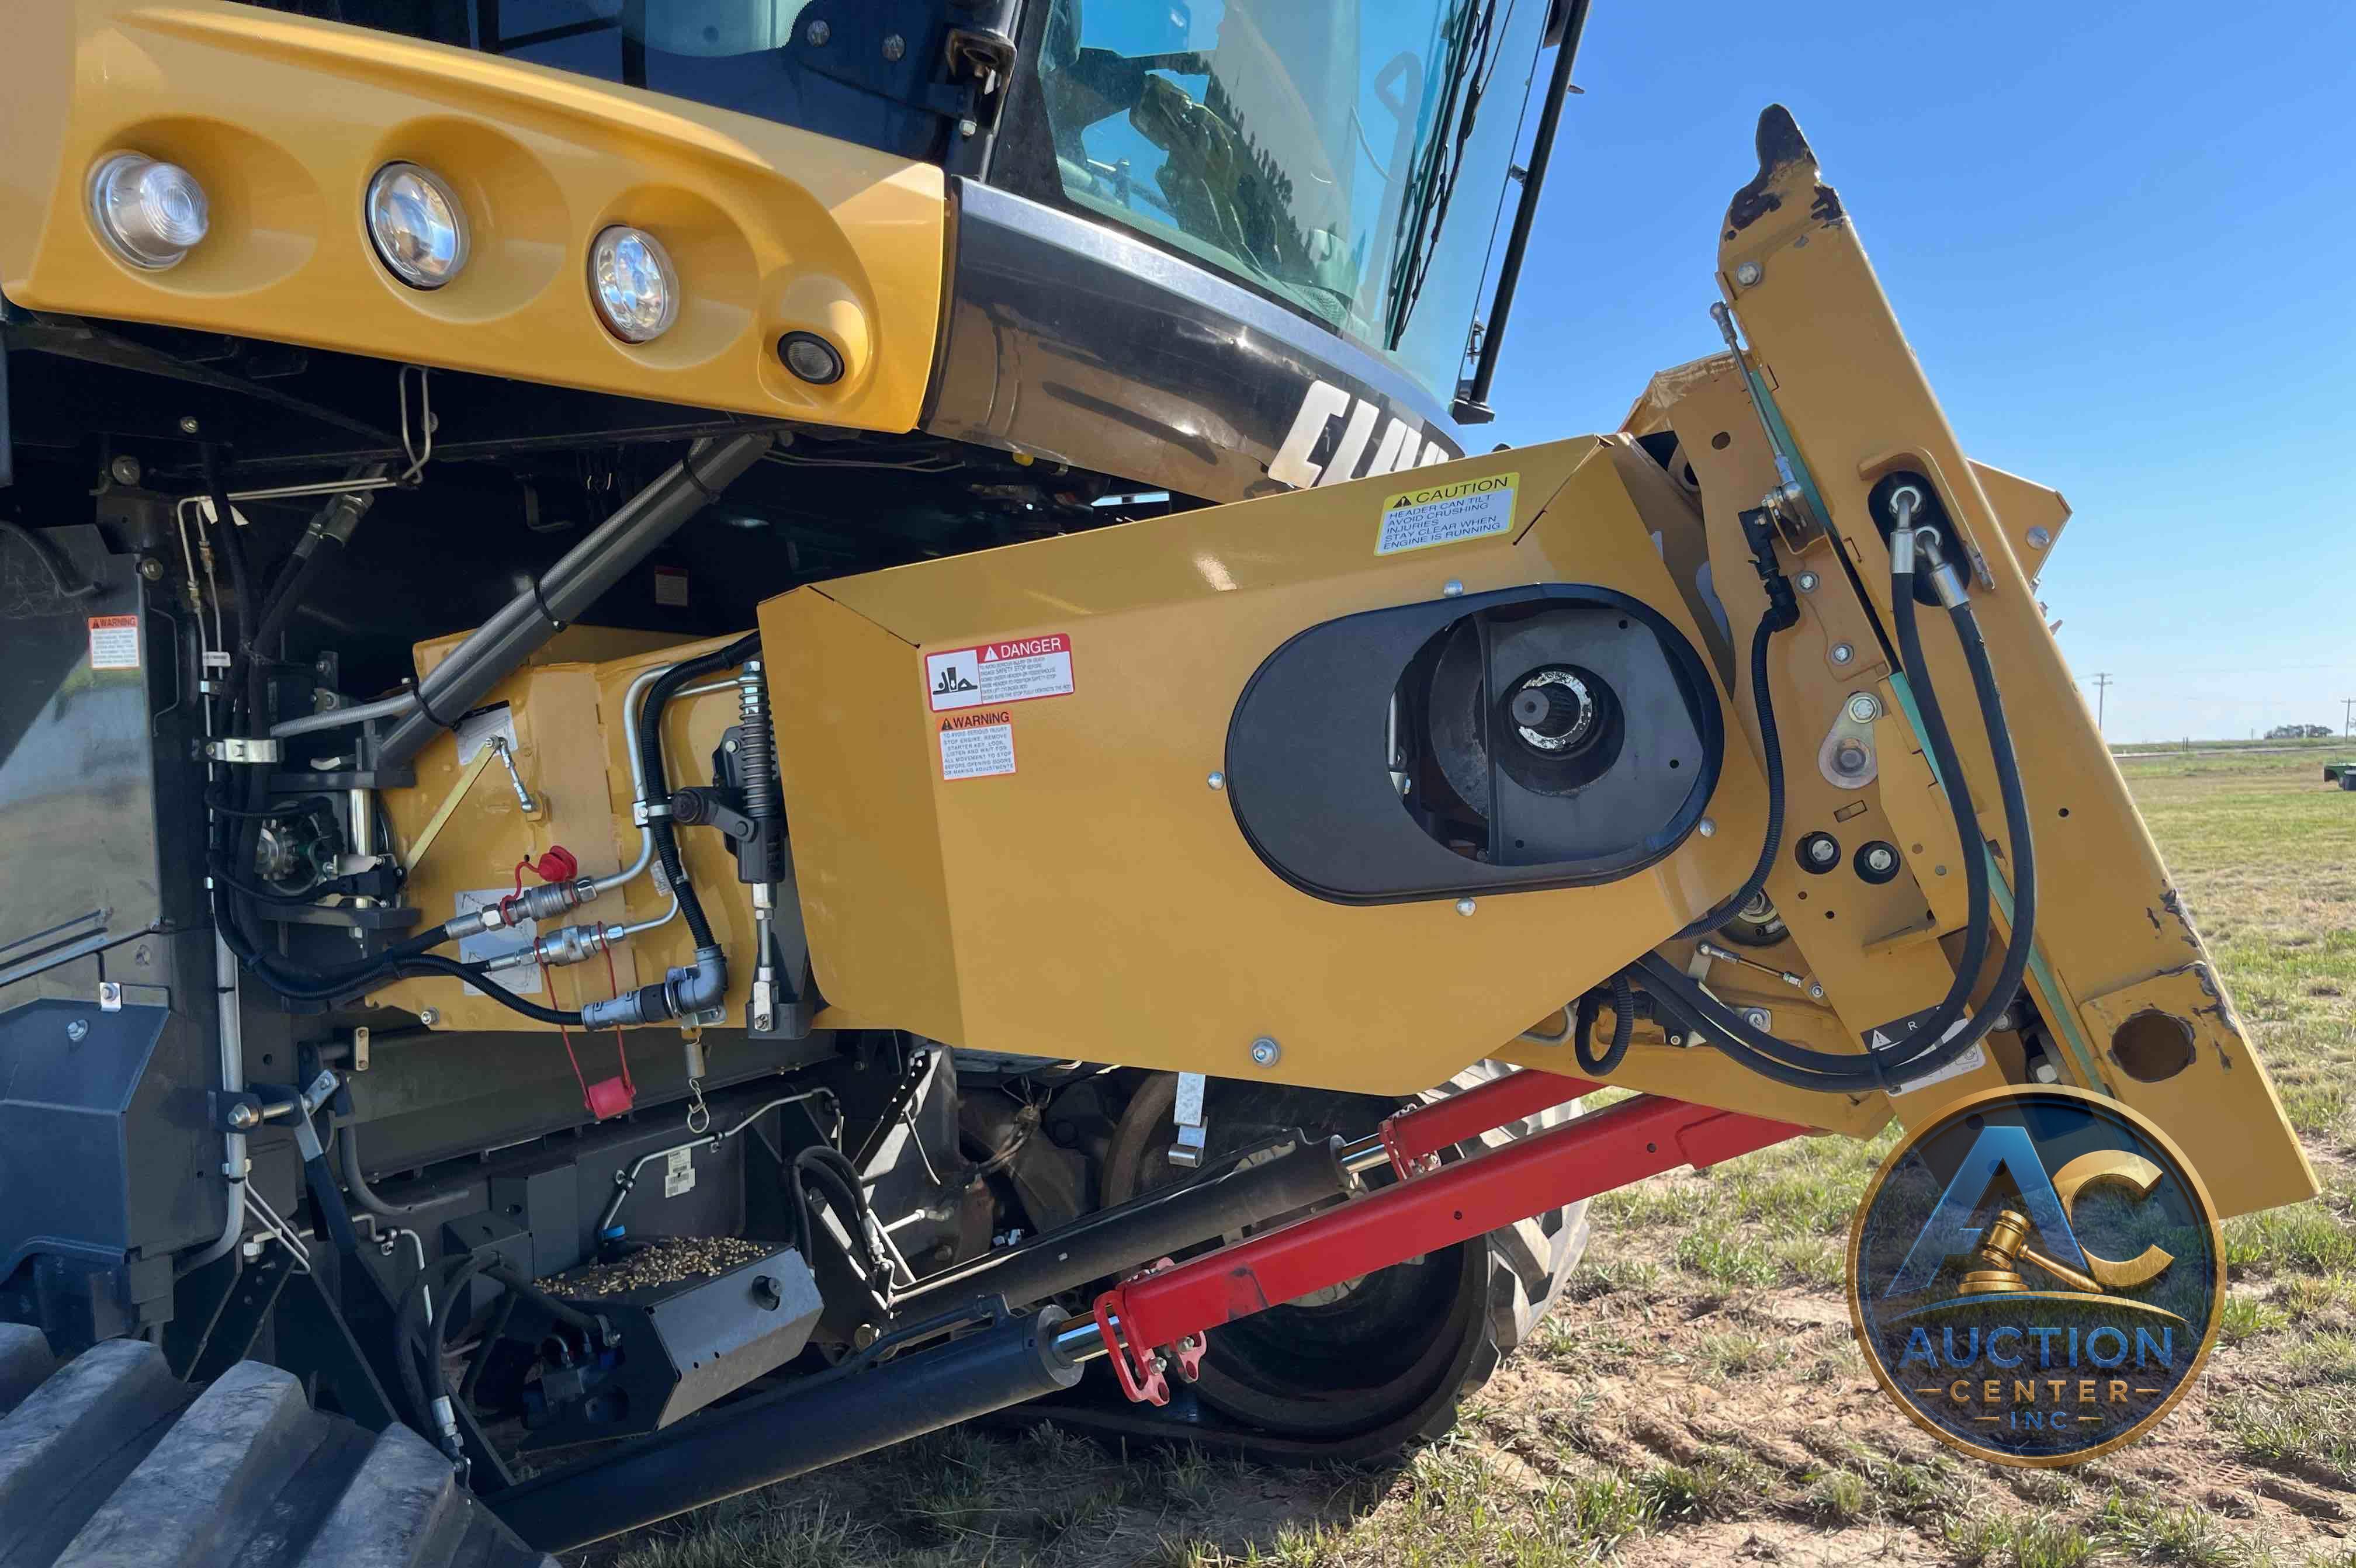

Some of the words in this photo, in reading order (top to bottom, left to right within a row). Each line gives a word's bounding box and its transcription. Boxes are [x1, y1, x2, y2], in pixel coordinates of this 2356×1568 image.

[1416, 477, 1508, 503] CAUTION
[1388, 515, 1423, 526] AVOID
[1427, 503, 1488, 519] CRUSHING
[1390, 505, 1436, 519] HEADER
[1440, 499, 1464, 510] CAN
[1384, 537, 1426, 550] ENGINE
[1446, 523, 1501, 538] RUNNING
[1385, 531, 1414, 542] STAY
[1418, 522, 1456, 536] CLEAR
[1461, 516, 1496, 527] WHEN
[1387, 519, 1439, 534] INJURIES
[99, 617, 137, 627] WARNING
[1000, 637, 1061, 658] DANGER
[953, 712, 1009, 729] WARNING
[955, 754, 986, 762] MOVEMENT
